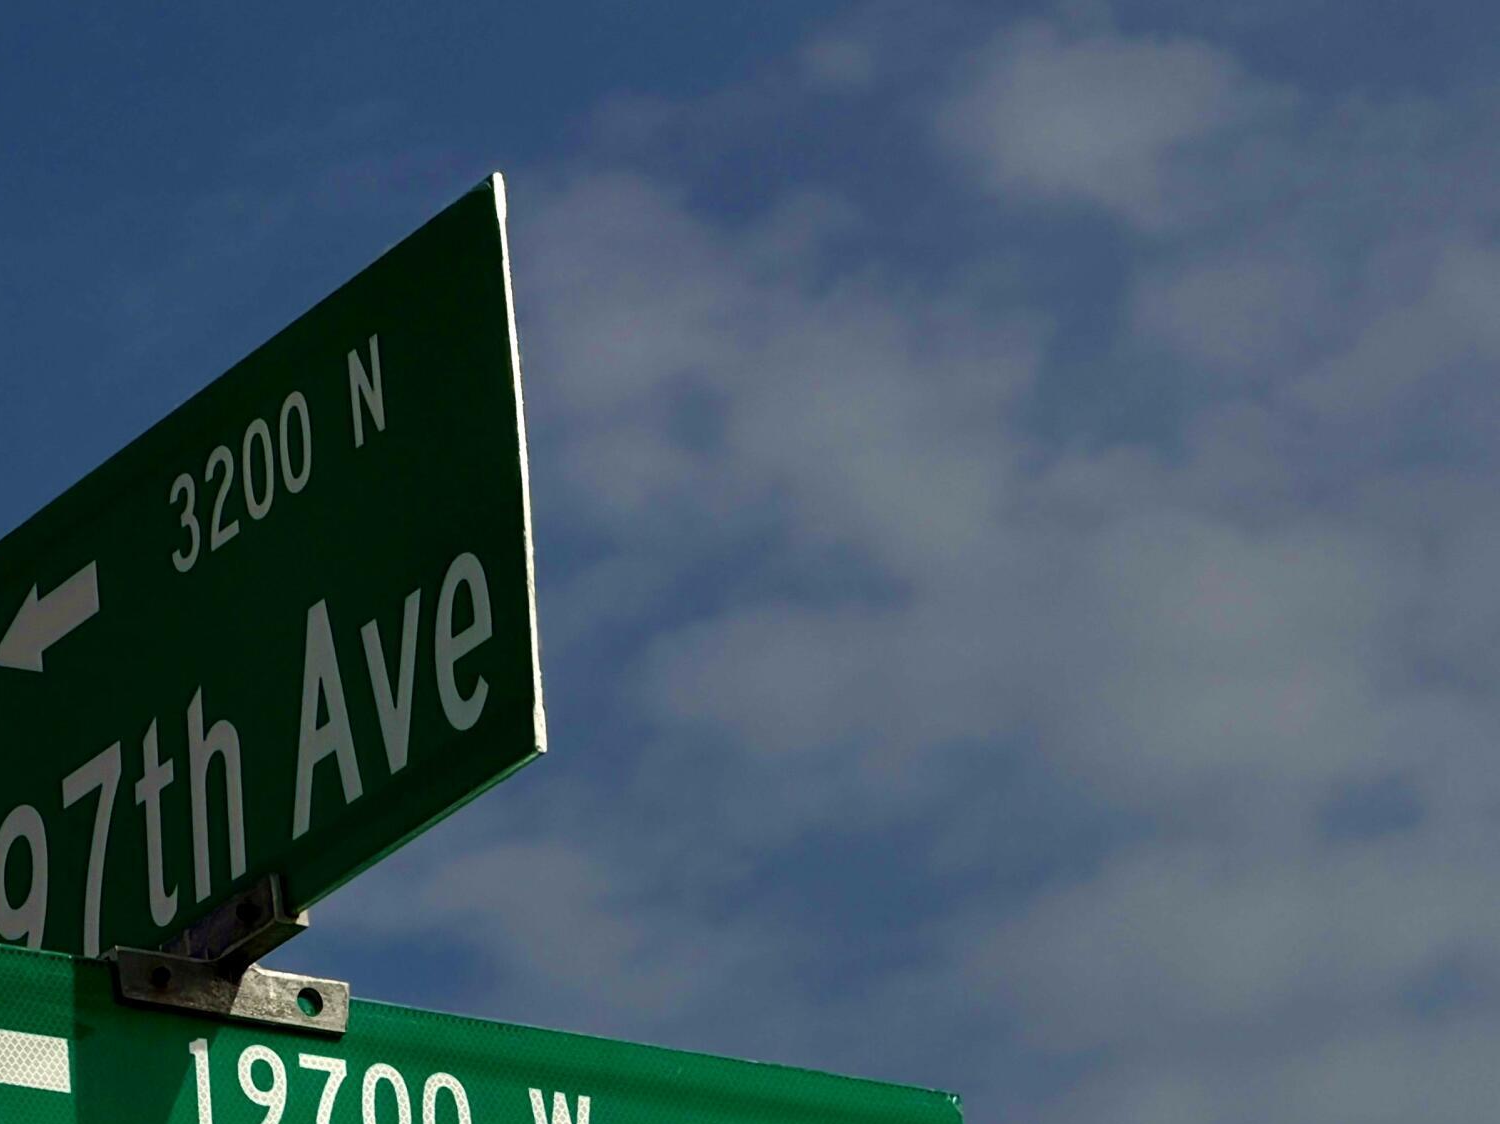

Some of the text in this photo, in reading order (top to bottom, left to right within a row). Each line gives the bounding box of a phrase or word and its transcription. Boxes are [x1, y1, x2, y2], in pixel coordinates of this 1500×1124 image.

[169, 334, 386, 574] 3200 N
[292, 551, 493, 841] Ave
